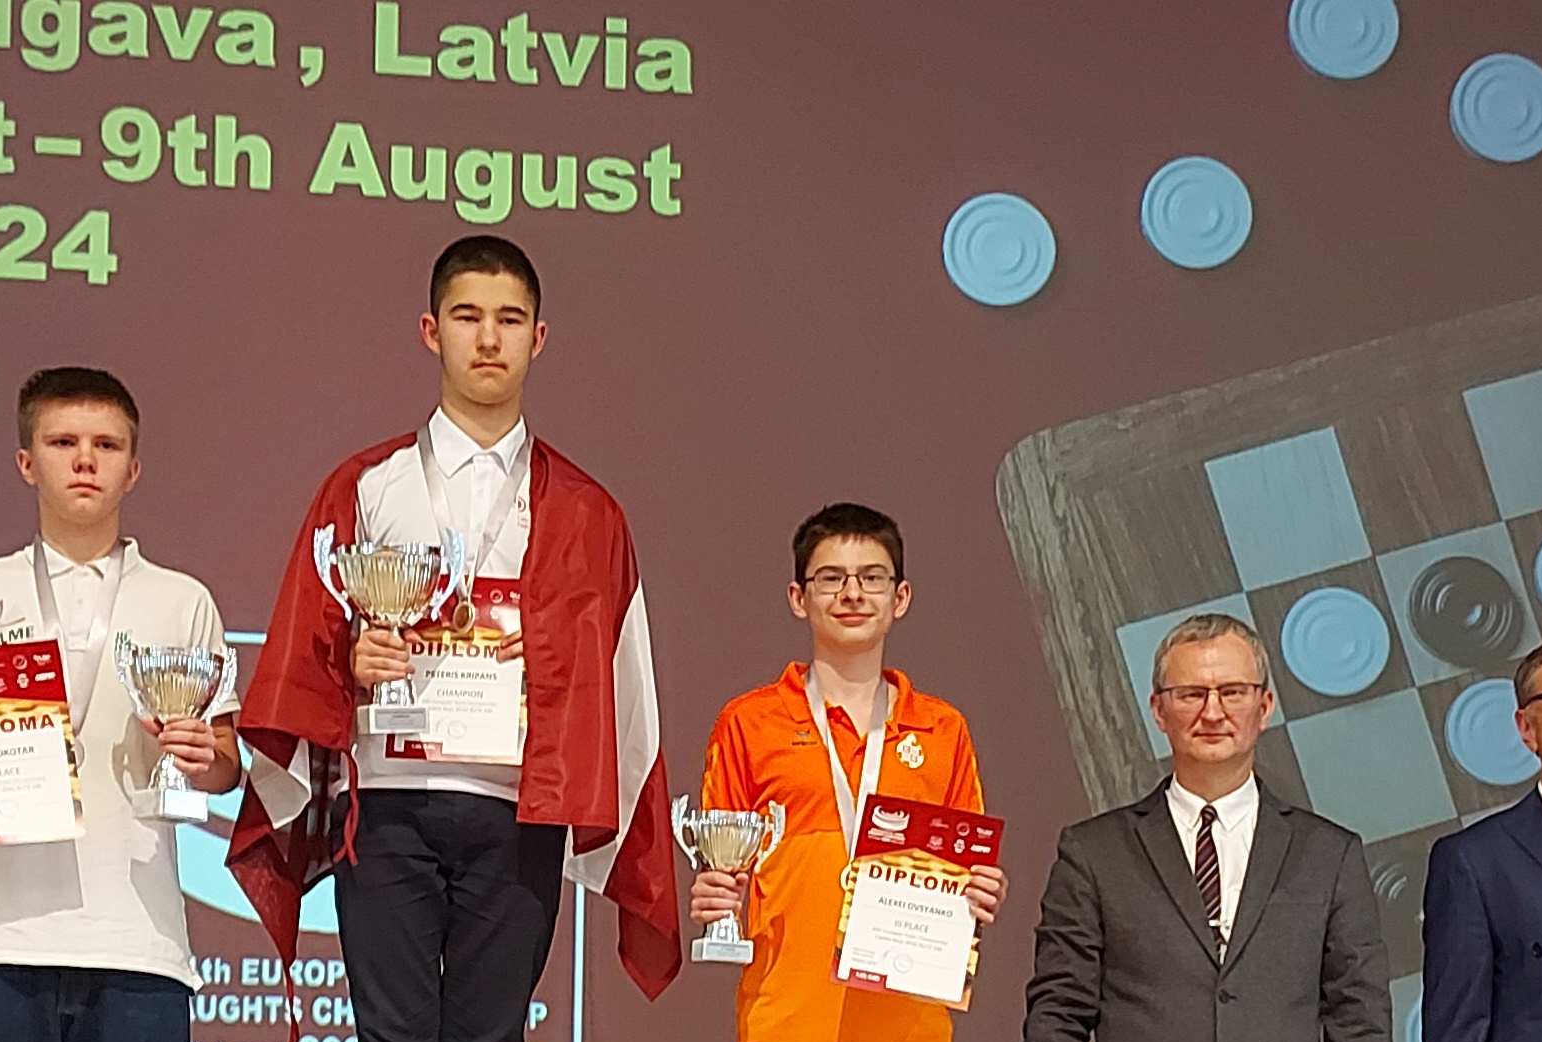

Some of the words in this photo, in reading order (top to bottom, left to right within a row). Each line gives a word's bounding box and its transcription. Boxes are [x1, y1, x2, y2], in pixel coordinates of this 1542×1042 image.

[375, 1, 693, 94] Latvia
[309, 122, 681, 224] August
[411, 642, 499, 659] DIPLOM
